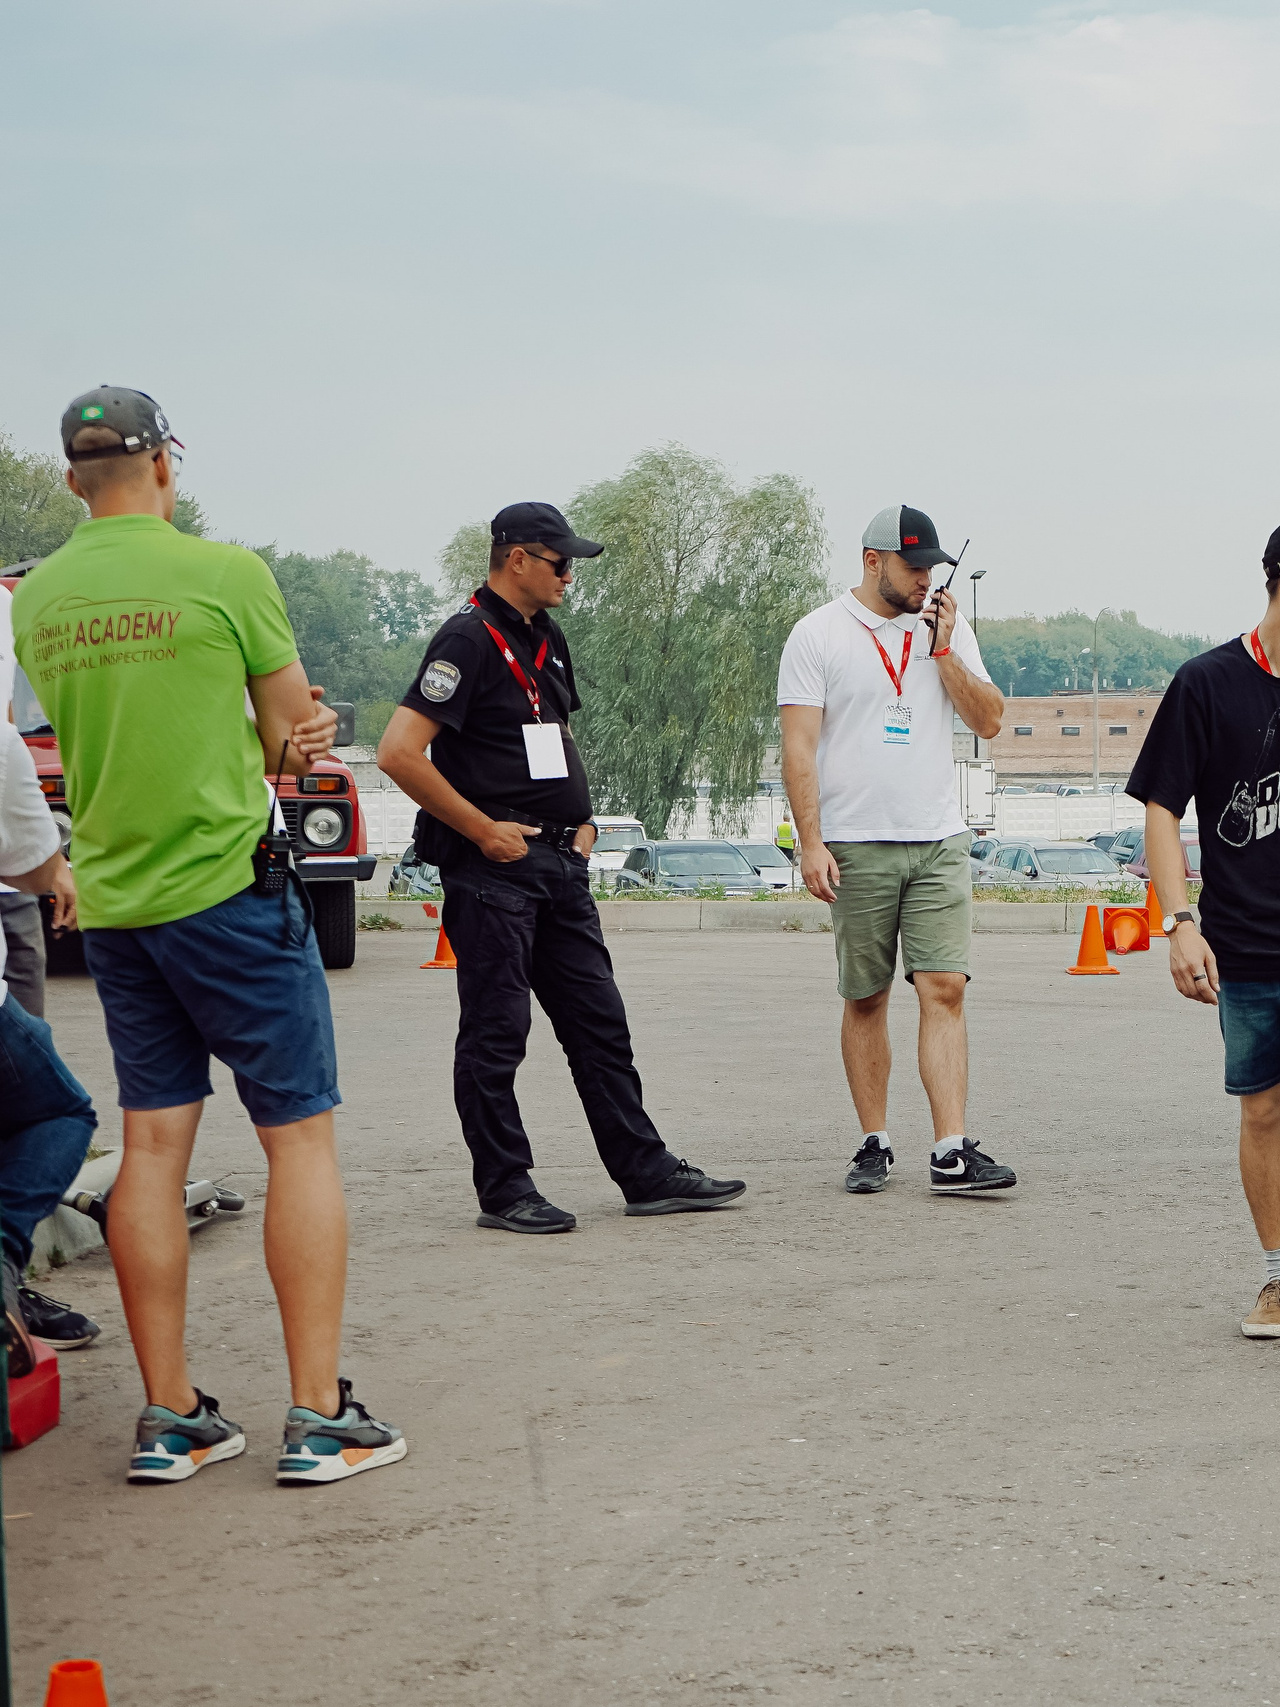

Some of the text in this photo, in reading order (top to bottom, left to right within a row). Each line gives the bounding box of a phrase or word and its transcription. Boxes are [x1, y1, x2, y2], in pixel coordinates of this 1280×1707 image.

[74, 611, 182, 648] ACADEMY
[39, 648, 177, 684] TECHNICAL INSPECTION
